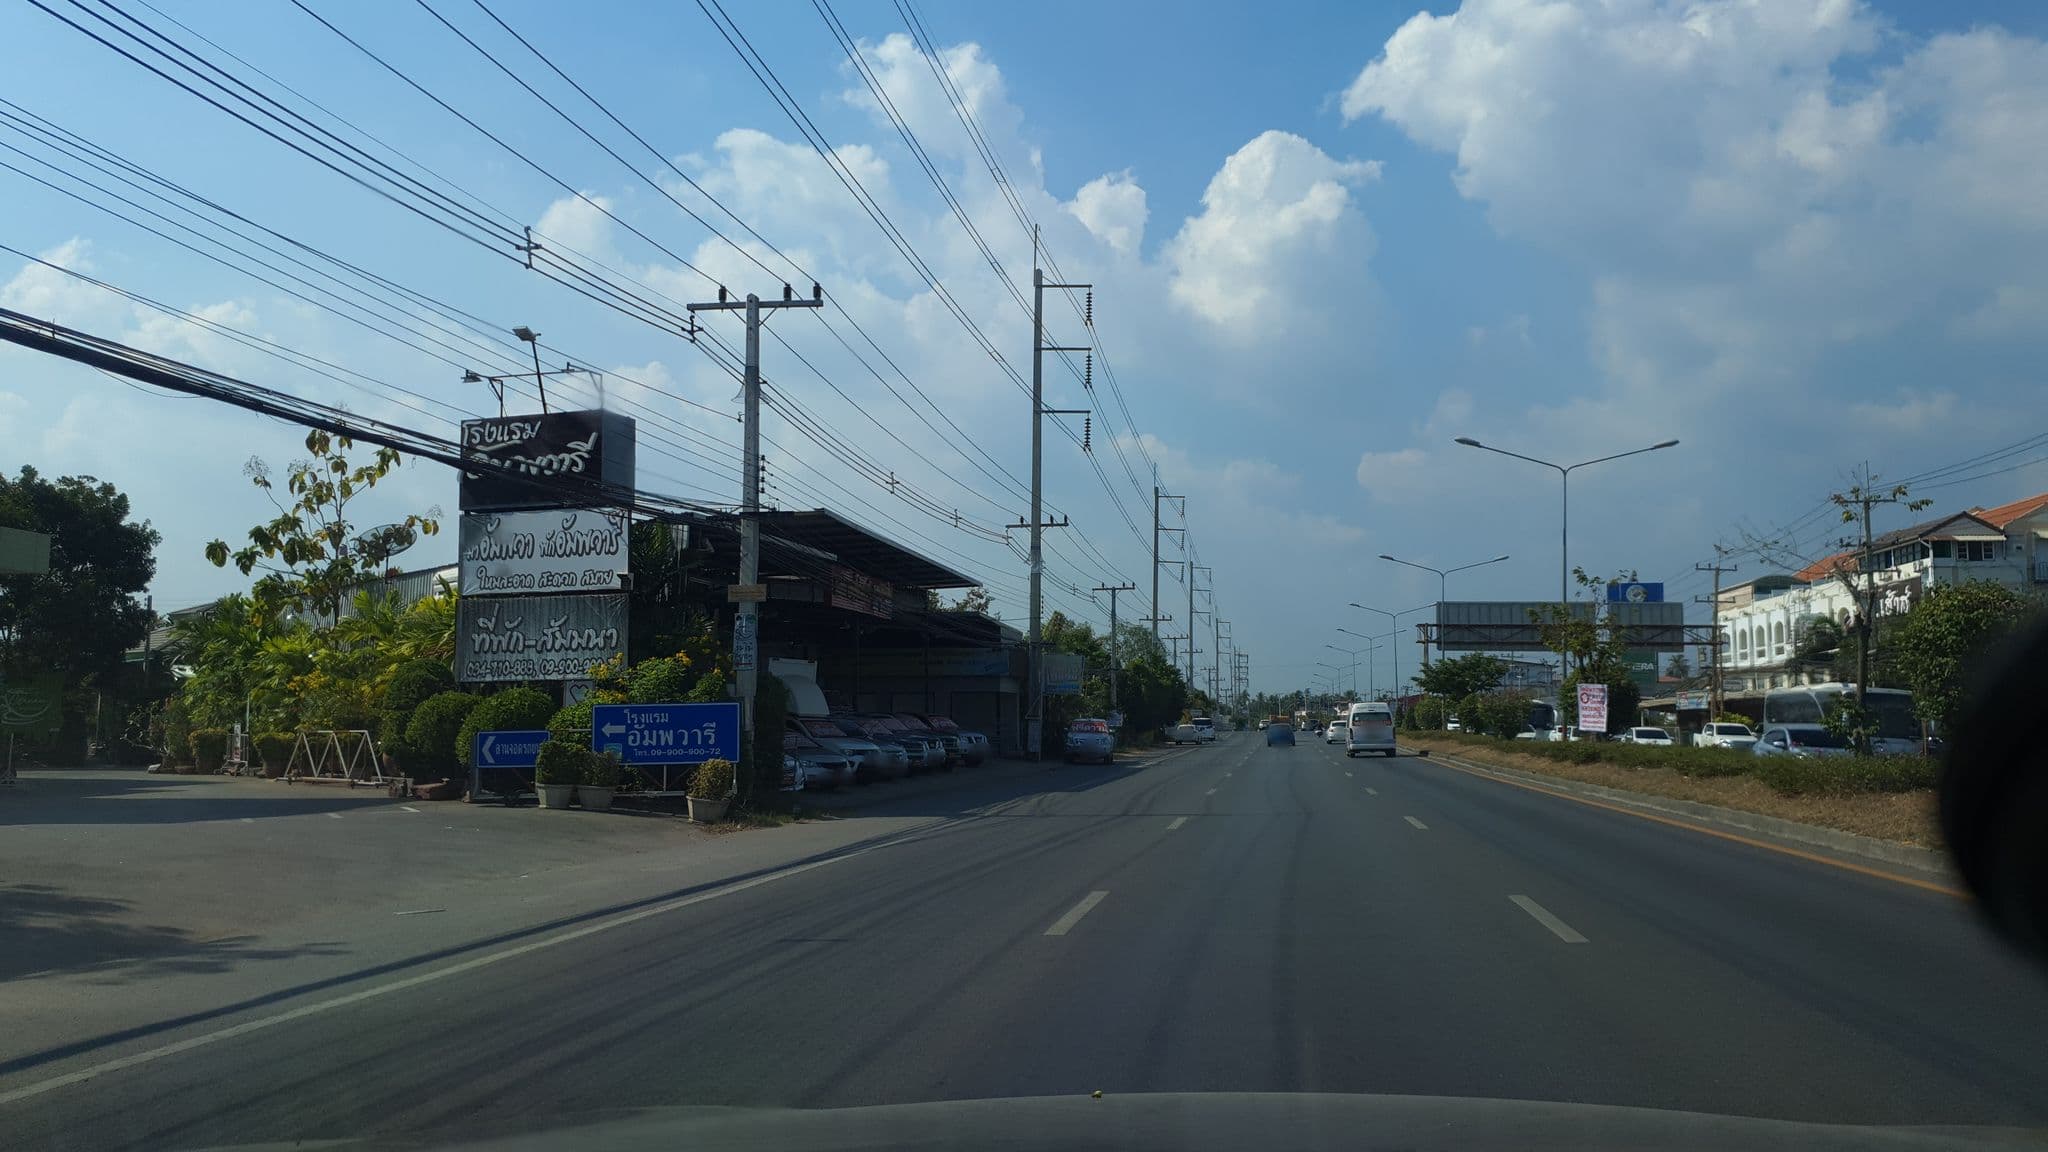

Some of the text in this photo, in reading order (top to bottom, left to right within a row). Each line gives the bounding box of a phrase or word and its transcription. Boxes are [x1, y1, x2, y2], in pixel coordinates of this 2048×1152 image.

[461, 421, 541, 447] โรงแรม
[537, 571, 578, 588] สะดวก
[624, 709, 669, 723] โรงแรม
[628, 722, 716, 746] อัมพวารี
